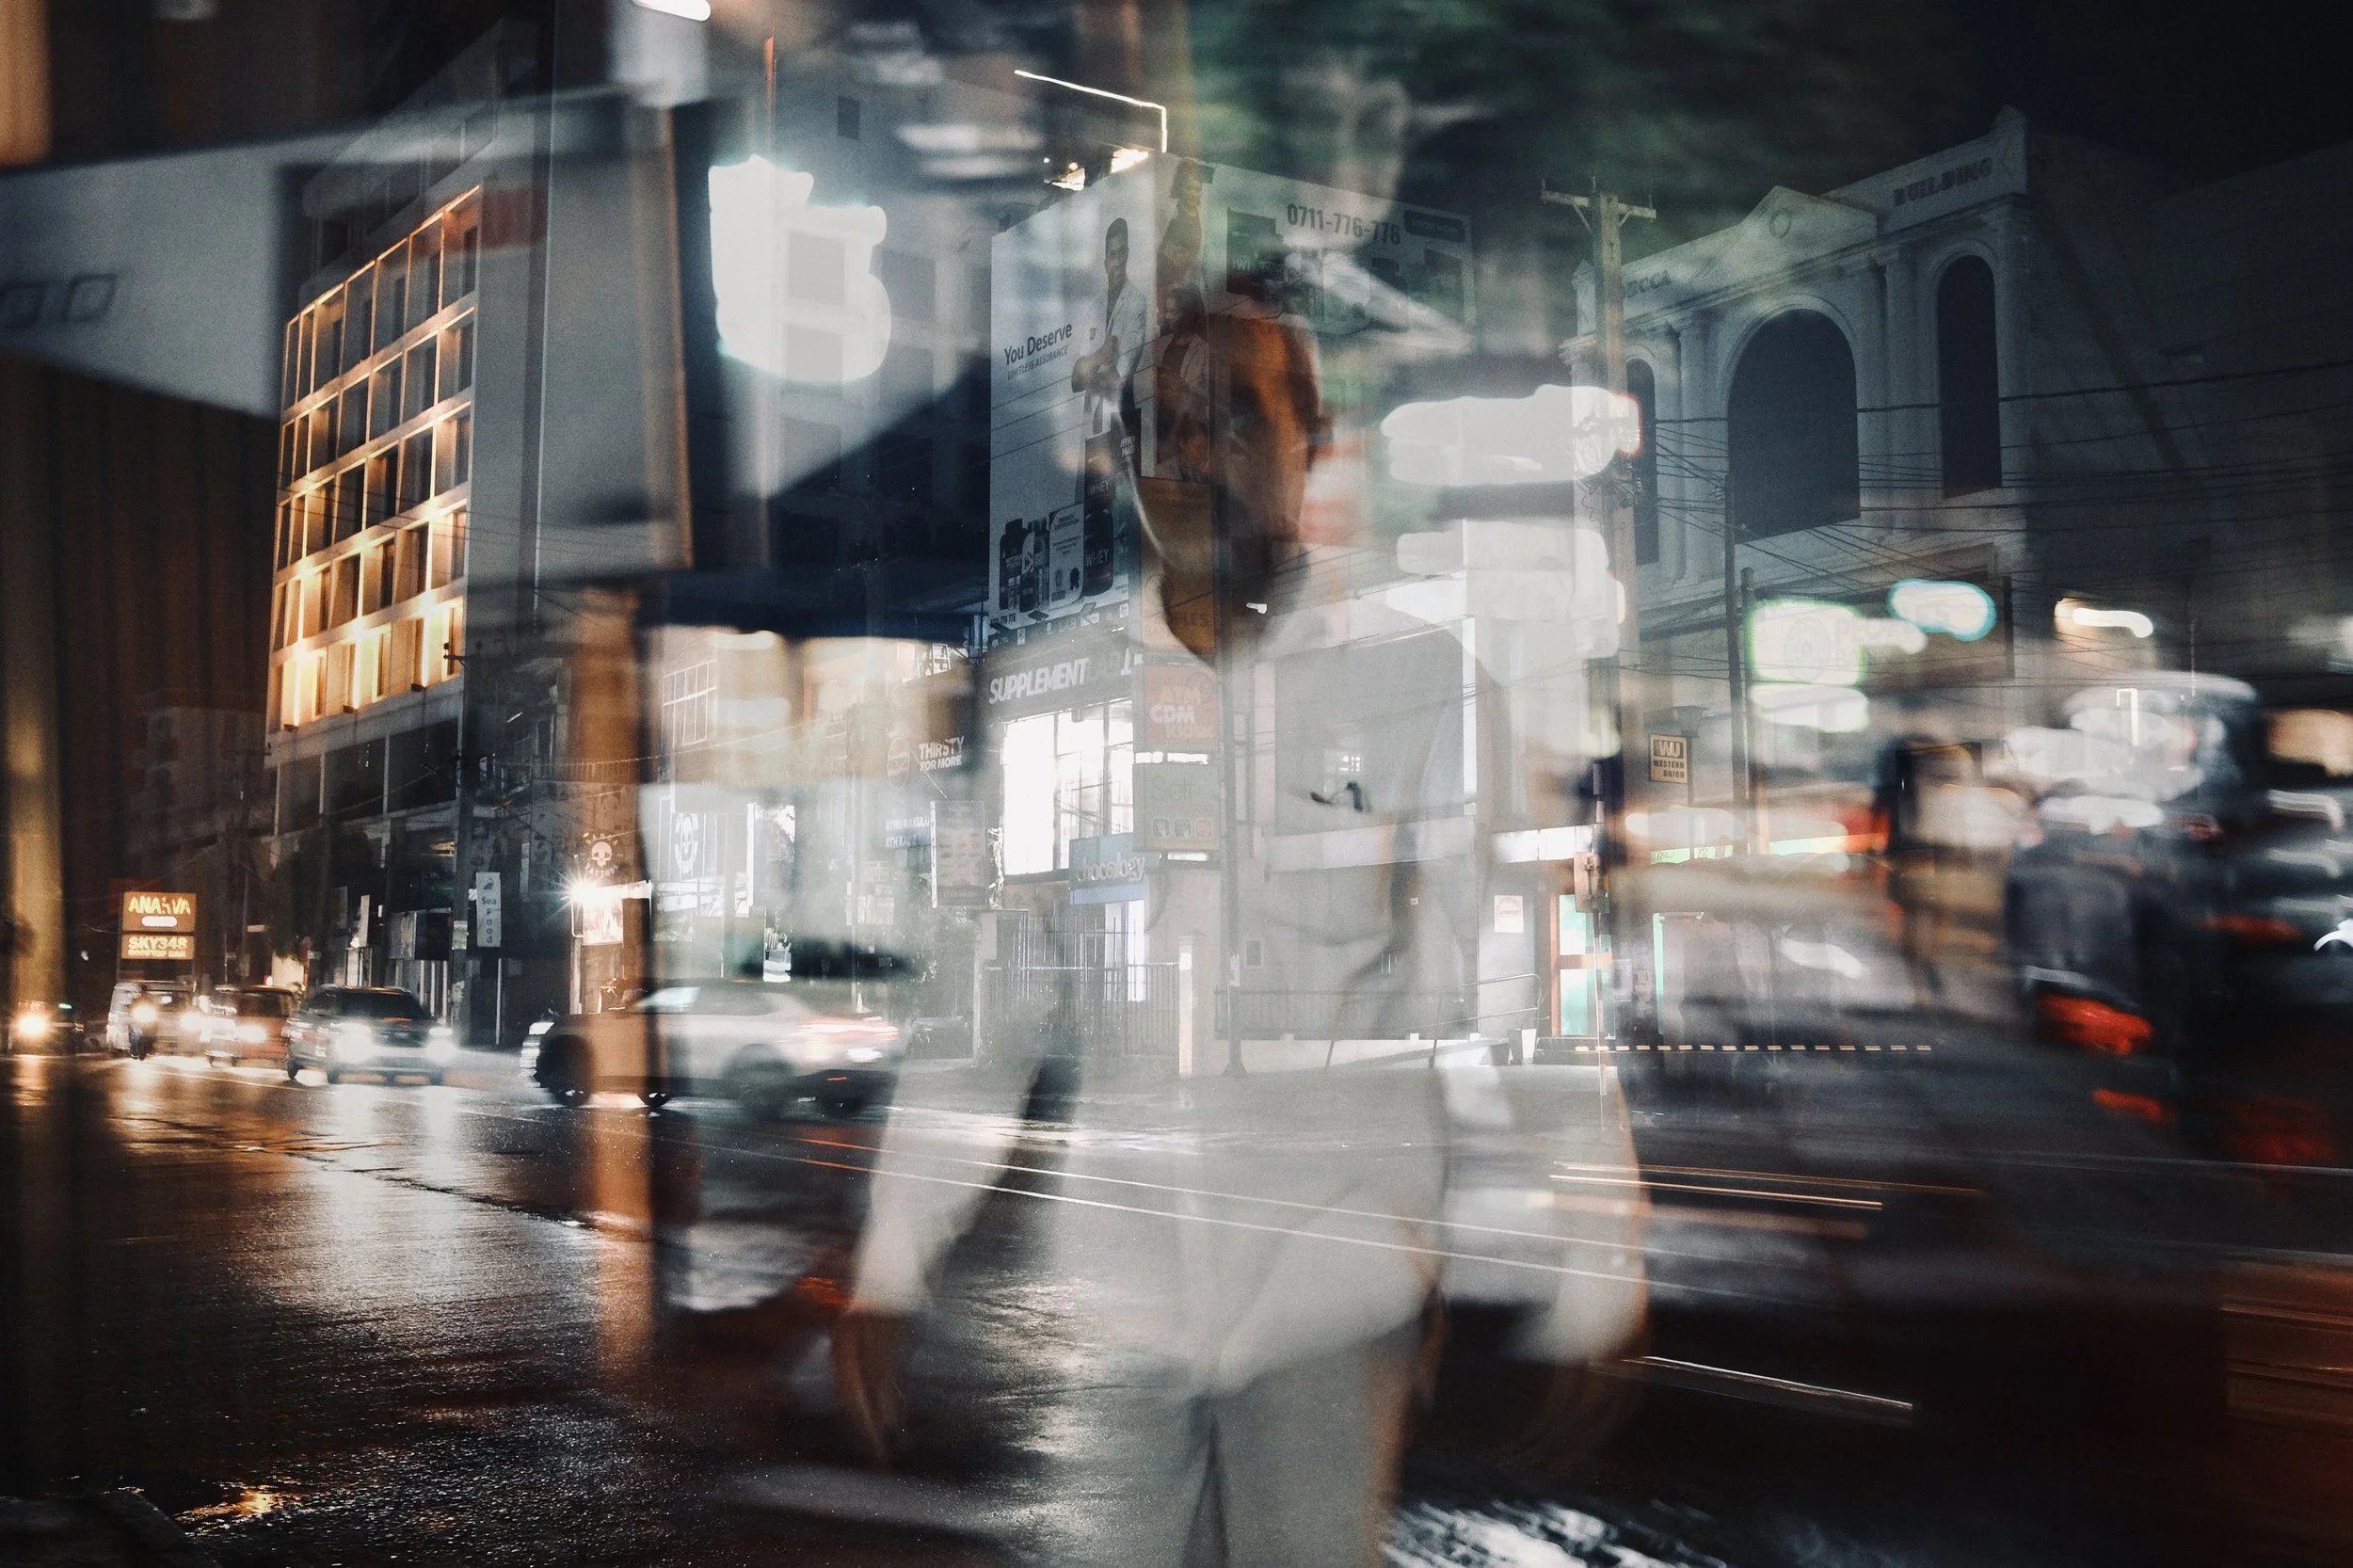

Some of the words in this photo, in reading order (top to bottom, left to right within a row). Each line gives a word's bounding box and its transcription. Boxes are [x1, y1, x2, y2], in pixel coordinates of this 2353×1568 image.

[1894, 157, 1993, 207] BUILDING
[1287, 203, 1401, 246] 0711-776-776
[1004, 345, 1024, 365] You
[1027, 324, 1072, 357] Deserve
[1007, 360, 1034, 381] LIMITLESS
[1034, 344, 1068, 368] ASSURANCE
[1089, 479, 1111, 495] WHEY
[1085, 549, 1110, 568] WHEY
[988, 658, 1089, 704] SUPPLEMENT
[1160, 686, 1202, 705] ATM
[1149, 704, 1196, 725] CDM
[919, 736, 965, 760] THIRSTY
[920, 760, 936, 773] FOR
[937, 755, 963, 770] MORE
[1653, 760, 1685, 769] WESTERN
[1663, 770, 1685, 778] UNION
[481, 896, 497, 905] Sea
[128, 936, 187, 950] SKY348
